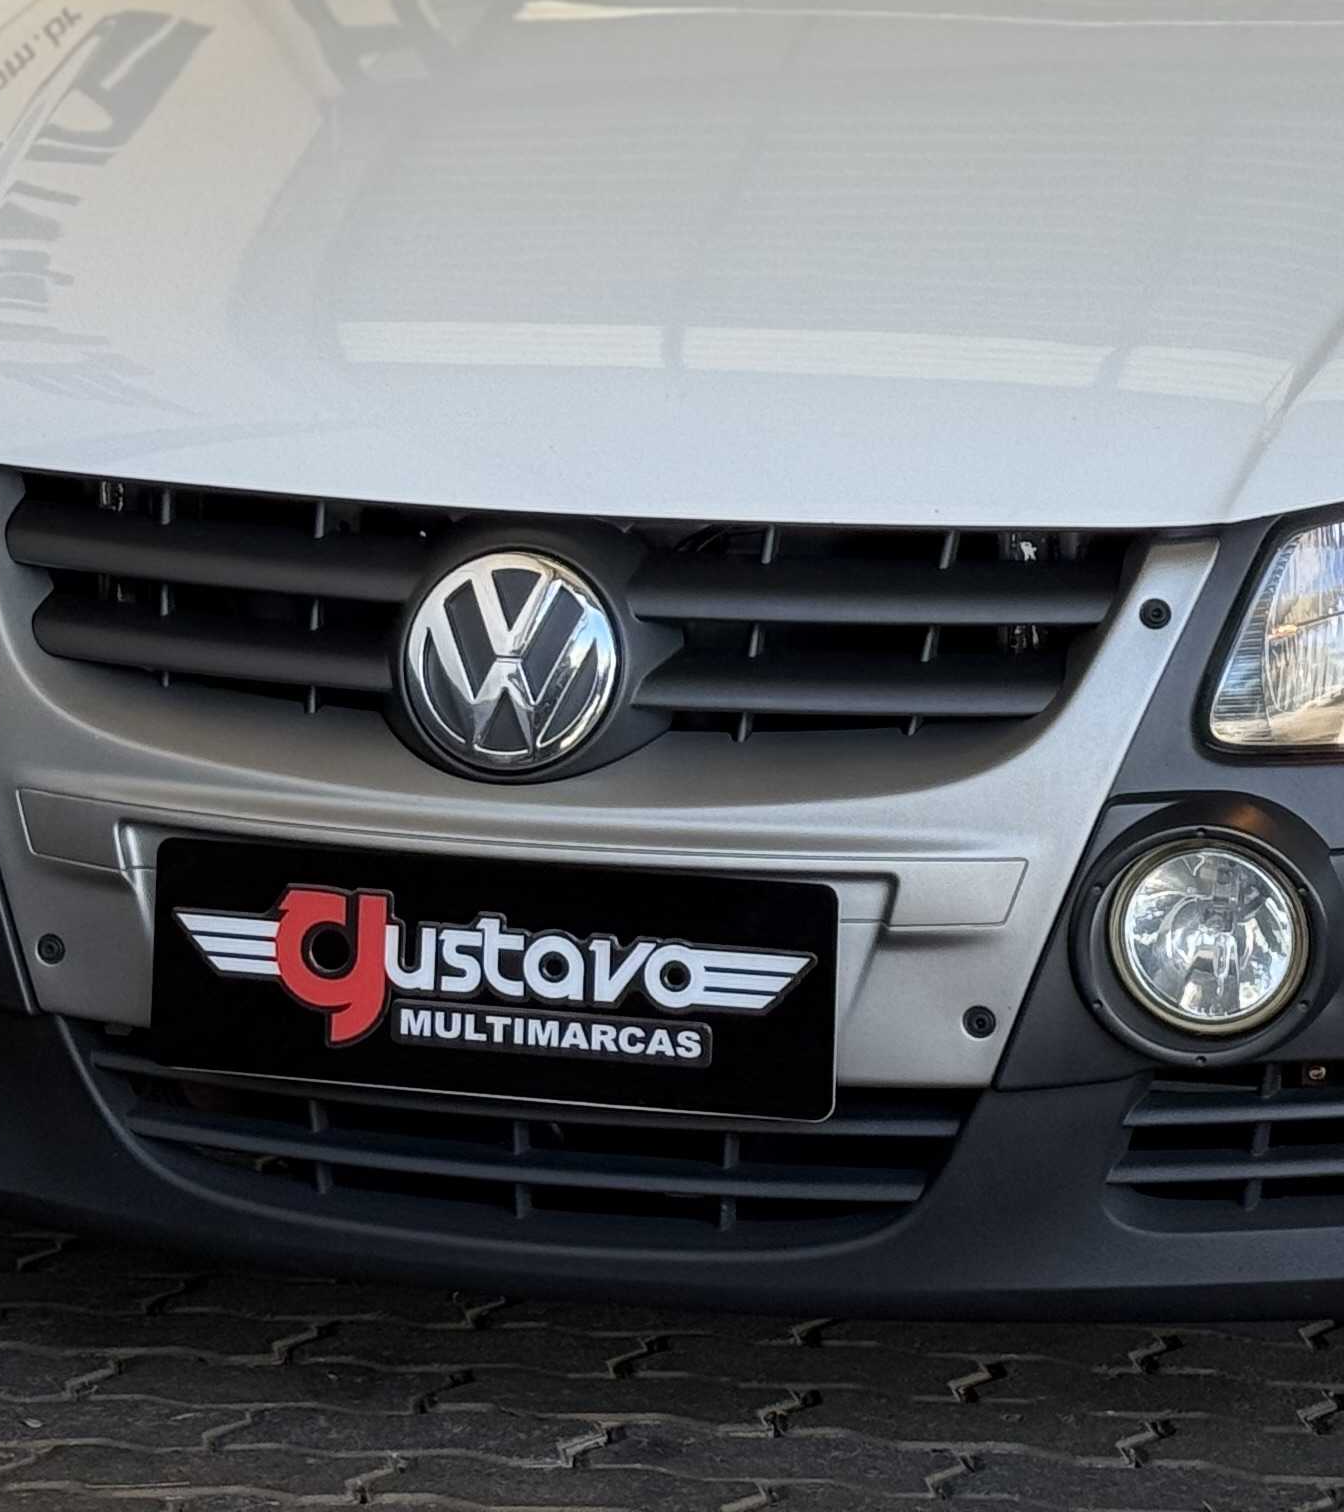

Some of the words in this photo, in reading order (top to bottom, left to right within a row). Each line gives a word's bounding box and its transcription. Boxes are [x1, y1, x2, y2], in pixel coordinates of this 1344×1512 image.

[413, 556, 613, 768] VW
[275, 888, 707, 1044] gustavo
[399, 1007, 703, 1061] MULTIMARCAS
